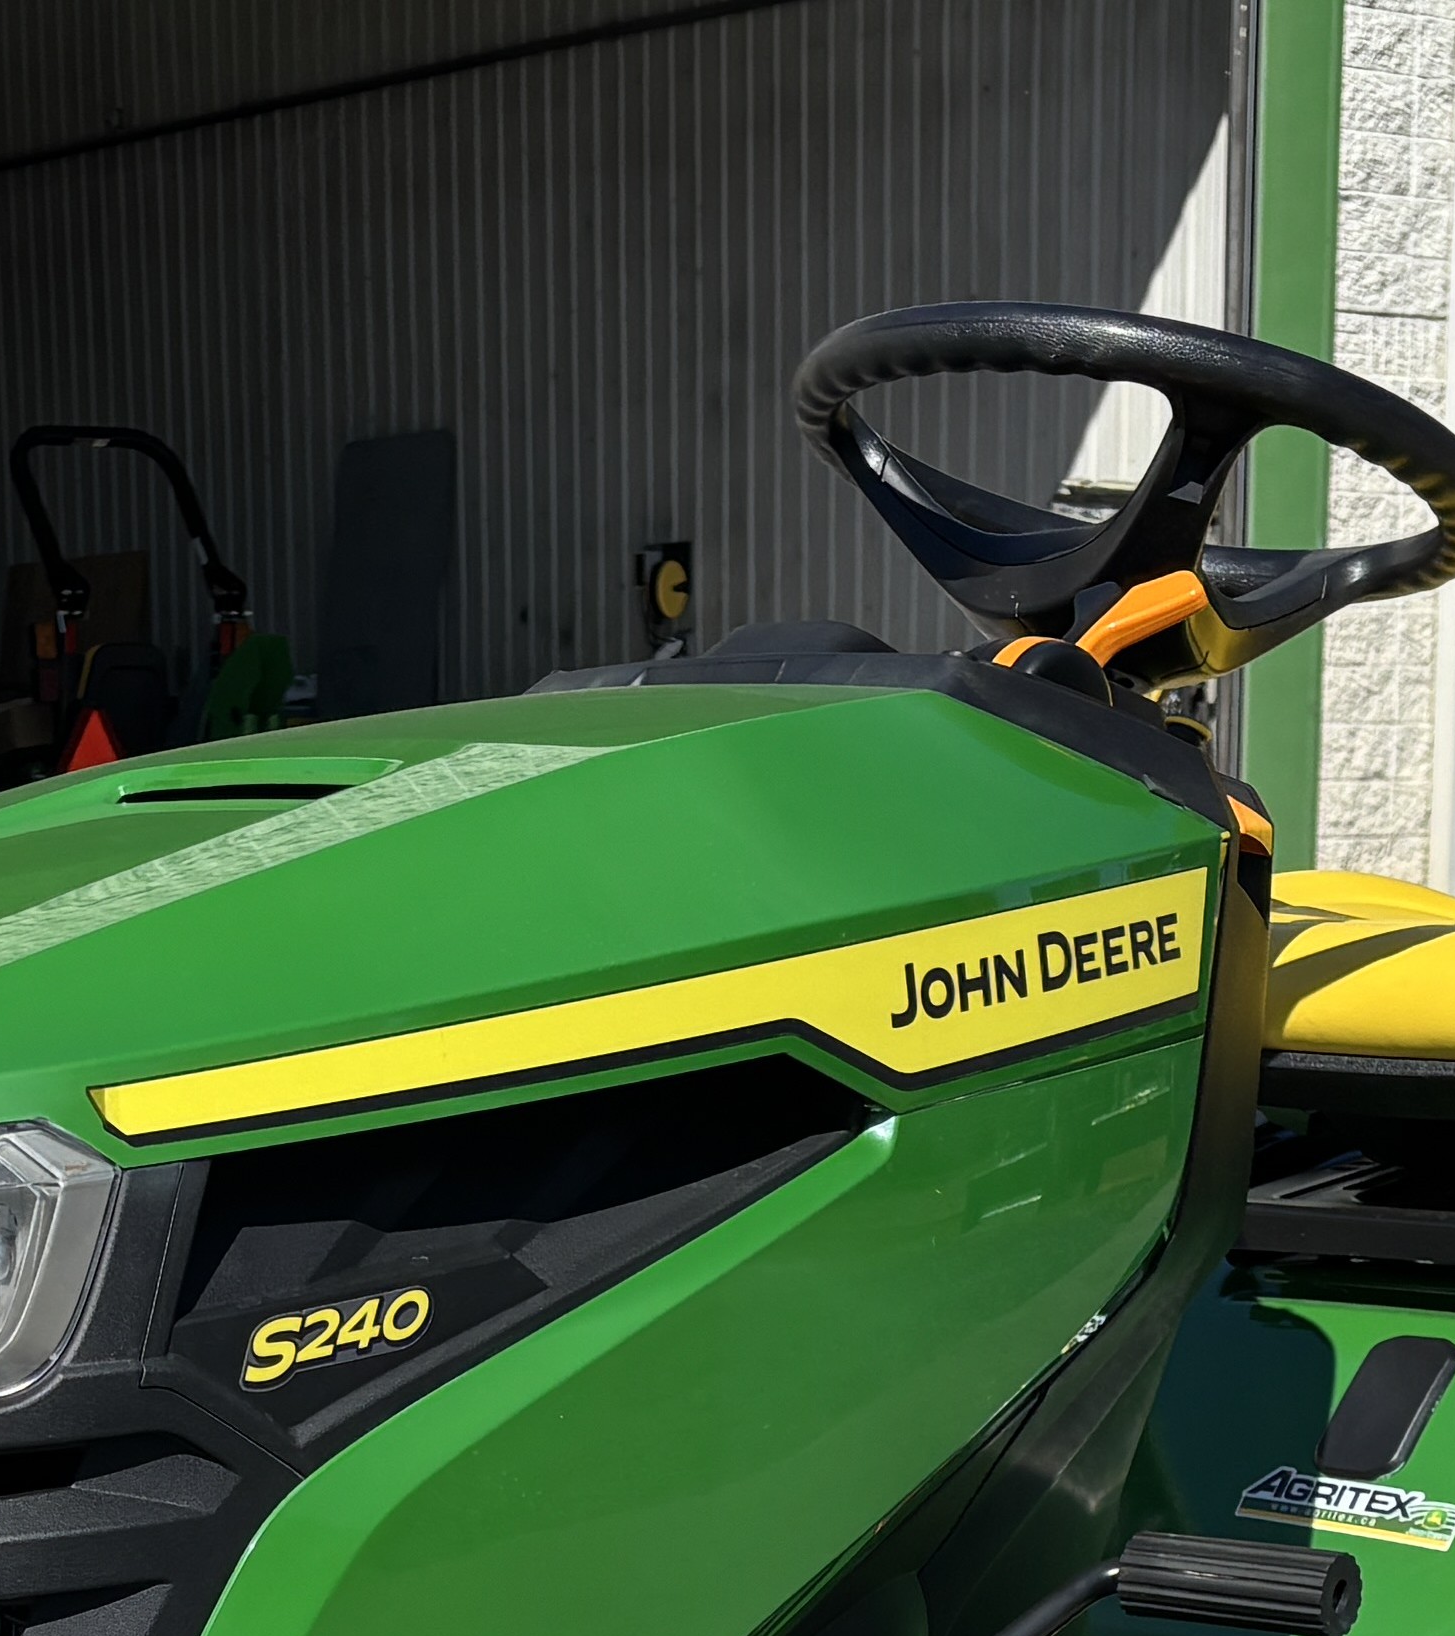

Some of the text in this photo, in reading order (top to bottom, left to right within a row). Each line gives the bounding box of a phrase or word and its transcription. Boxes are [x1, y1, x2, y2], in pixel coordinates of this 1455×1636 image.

[891, 912, 1182, 1028] JOHN DEERE
[245, 1289, 430, 1383] S240
[1246, 1469, 1419, 1520] AGRITEX
